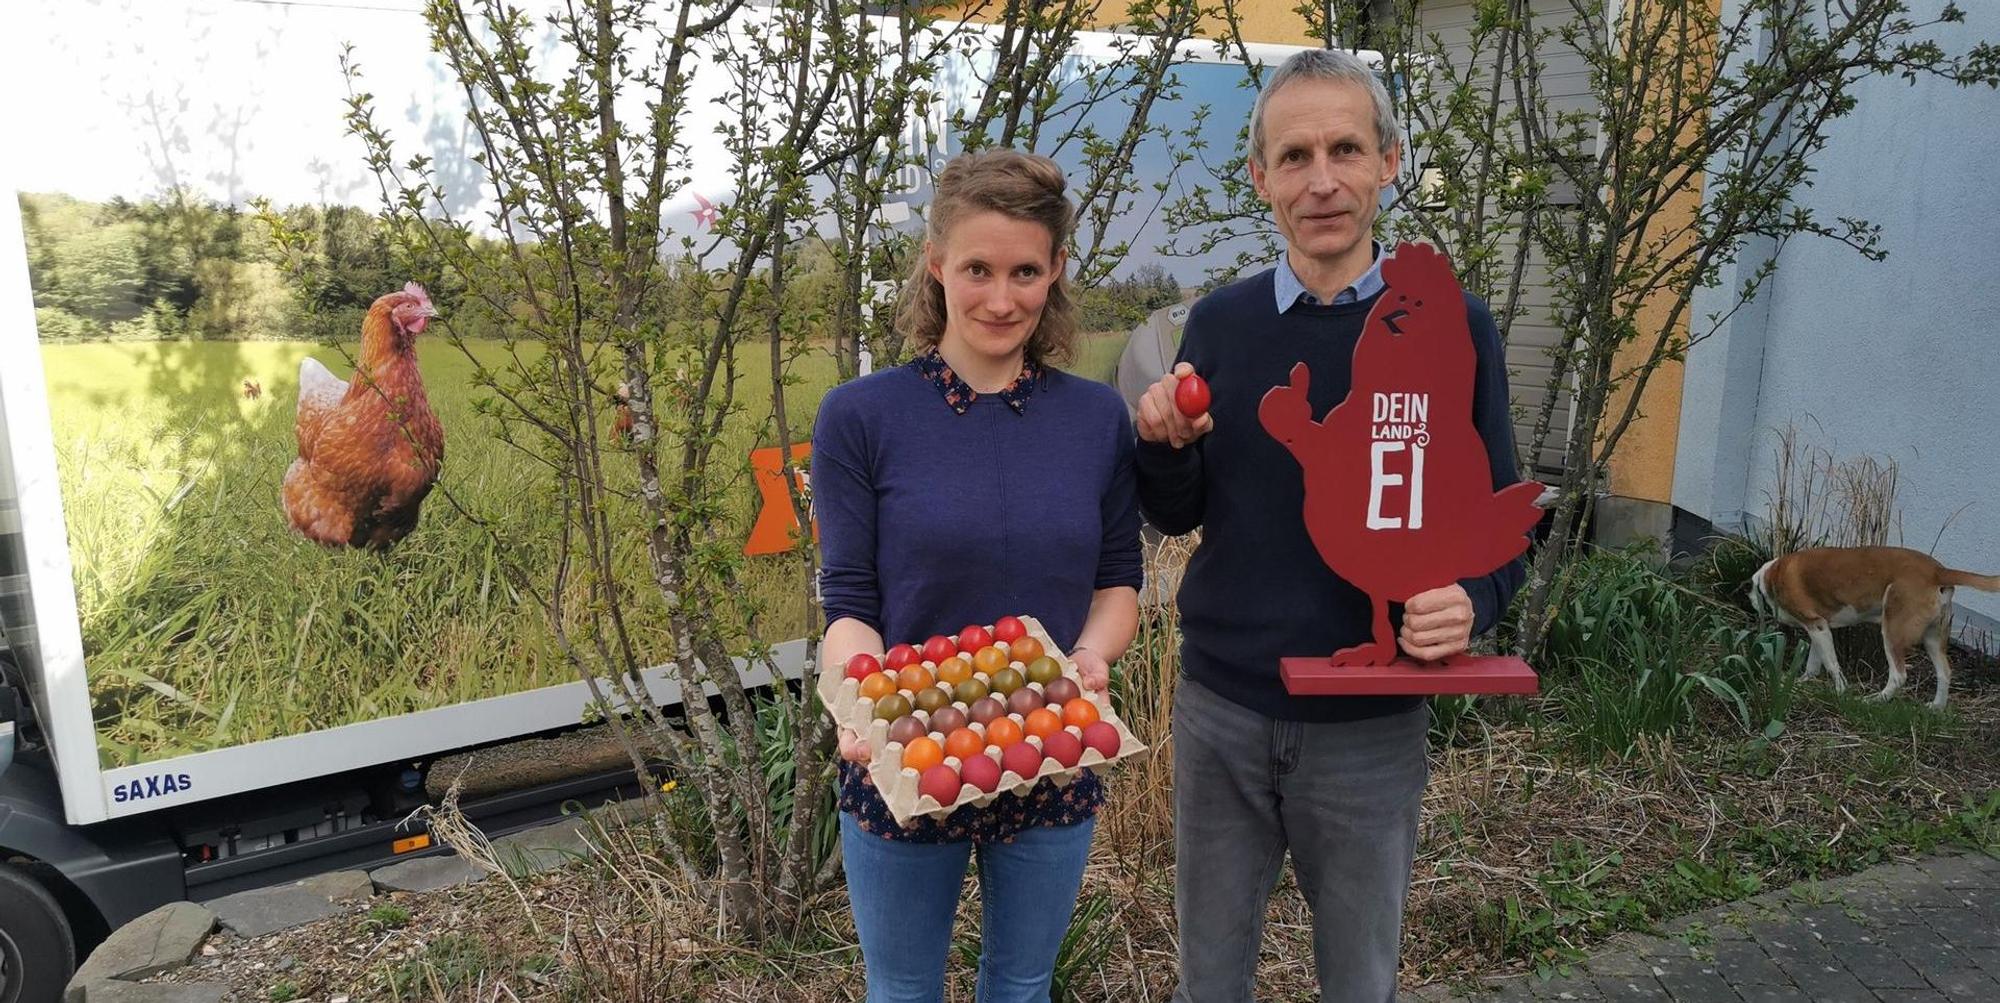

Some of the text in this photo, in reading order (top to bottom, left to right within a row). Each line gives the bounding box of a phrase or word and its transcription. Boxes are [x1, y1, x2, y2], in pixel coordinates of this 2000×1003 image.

[1372, 392, 1429, 423] DEIN
[1371, 425, 1412, 439] LAND
[1366, 441, 1424, 530] EI
[114, 774, 192, 803] SAXAS
